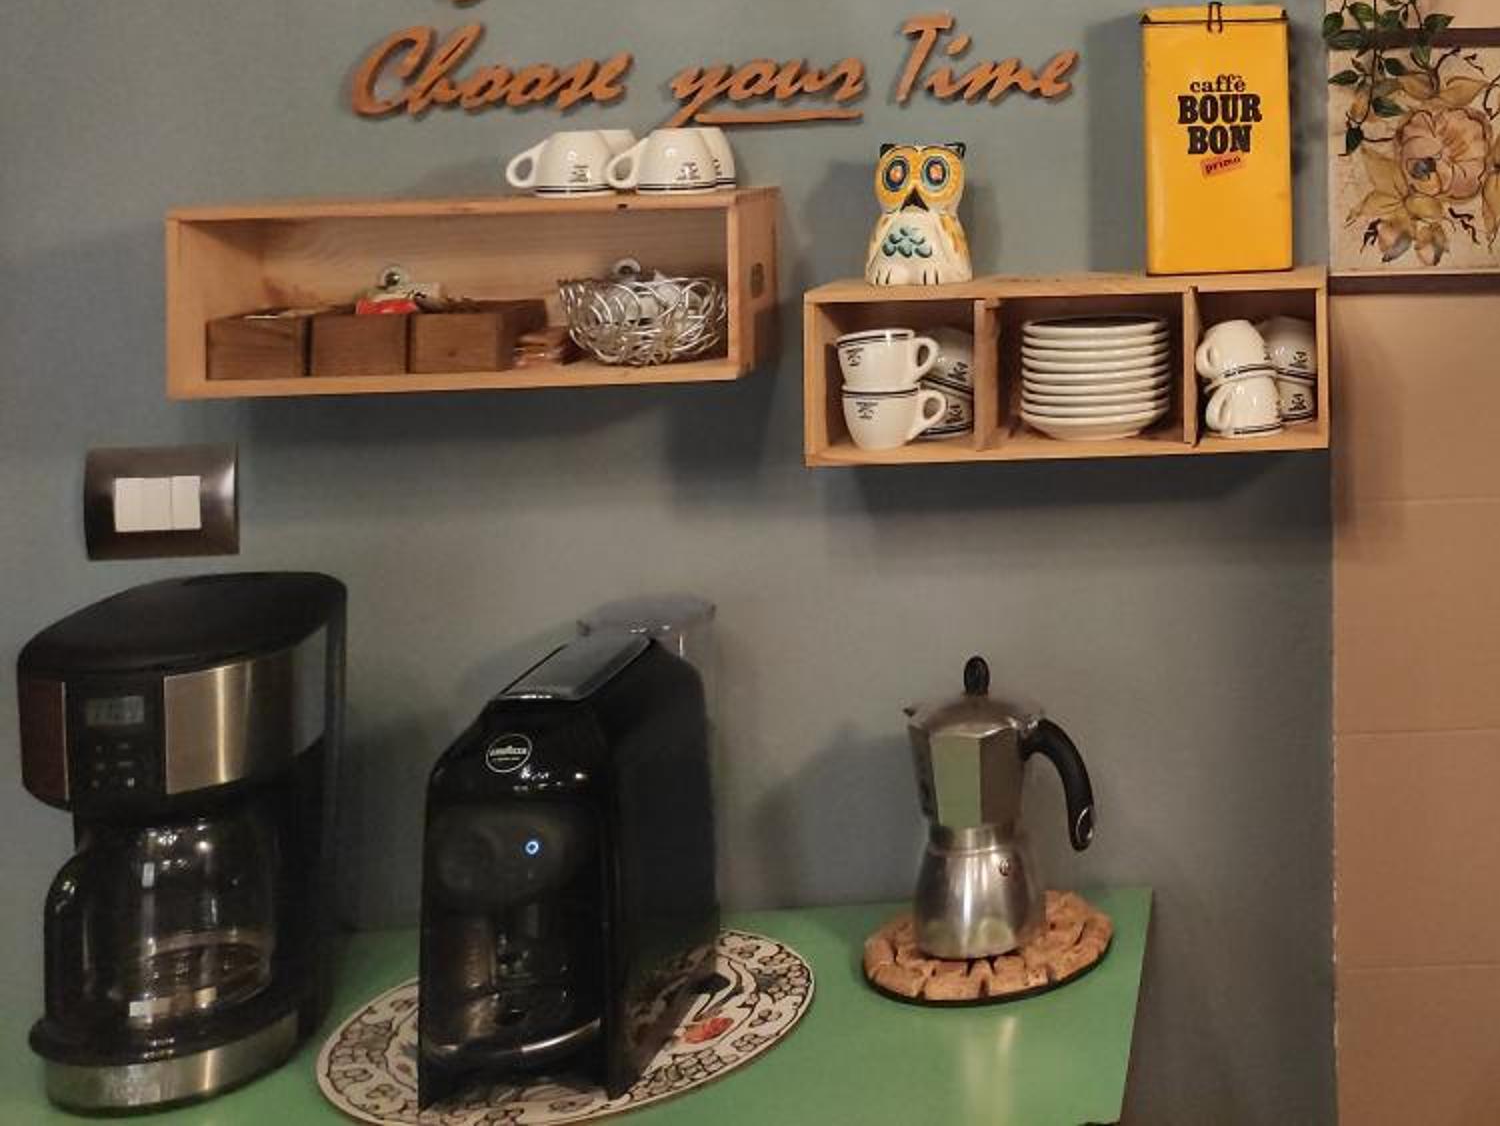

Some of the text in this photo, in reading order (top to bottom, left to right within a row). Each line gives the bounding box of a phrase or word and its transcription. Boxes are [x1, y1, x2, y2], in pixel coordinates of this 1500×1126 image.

[351, 12, 1081, 128] Choose your Time
[1177, 93, 1262, 124] BOUR
[1187, 125, 1252, 154] BON
